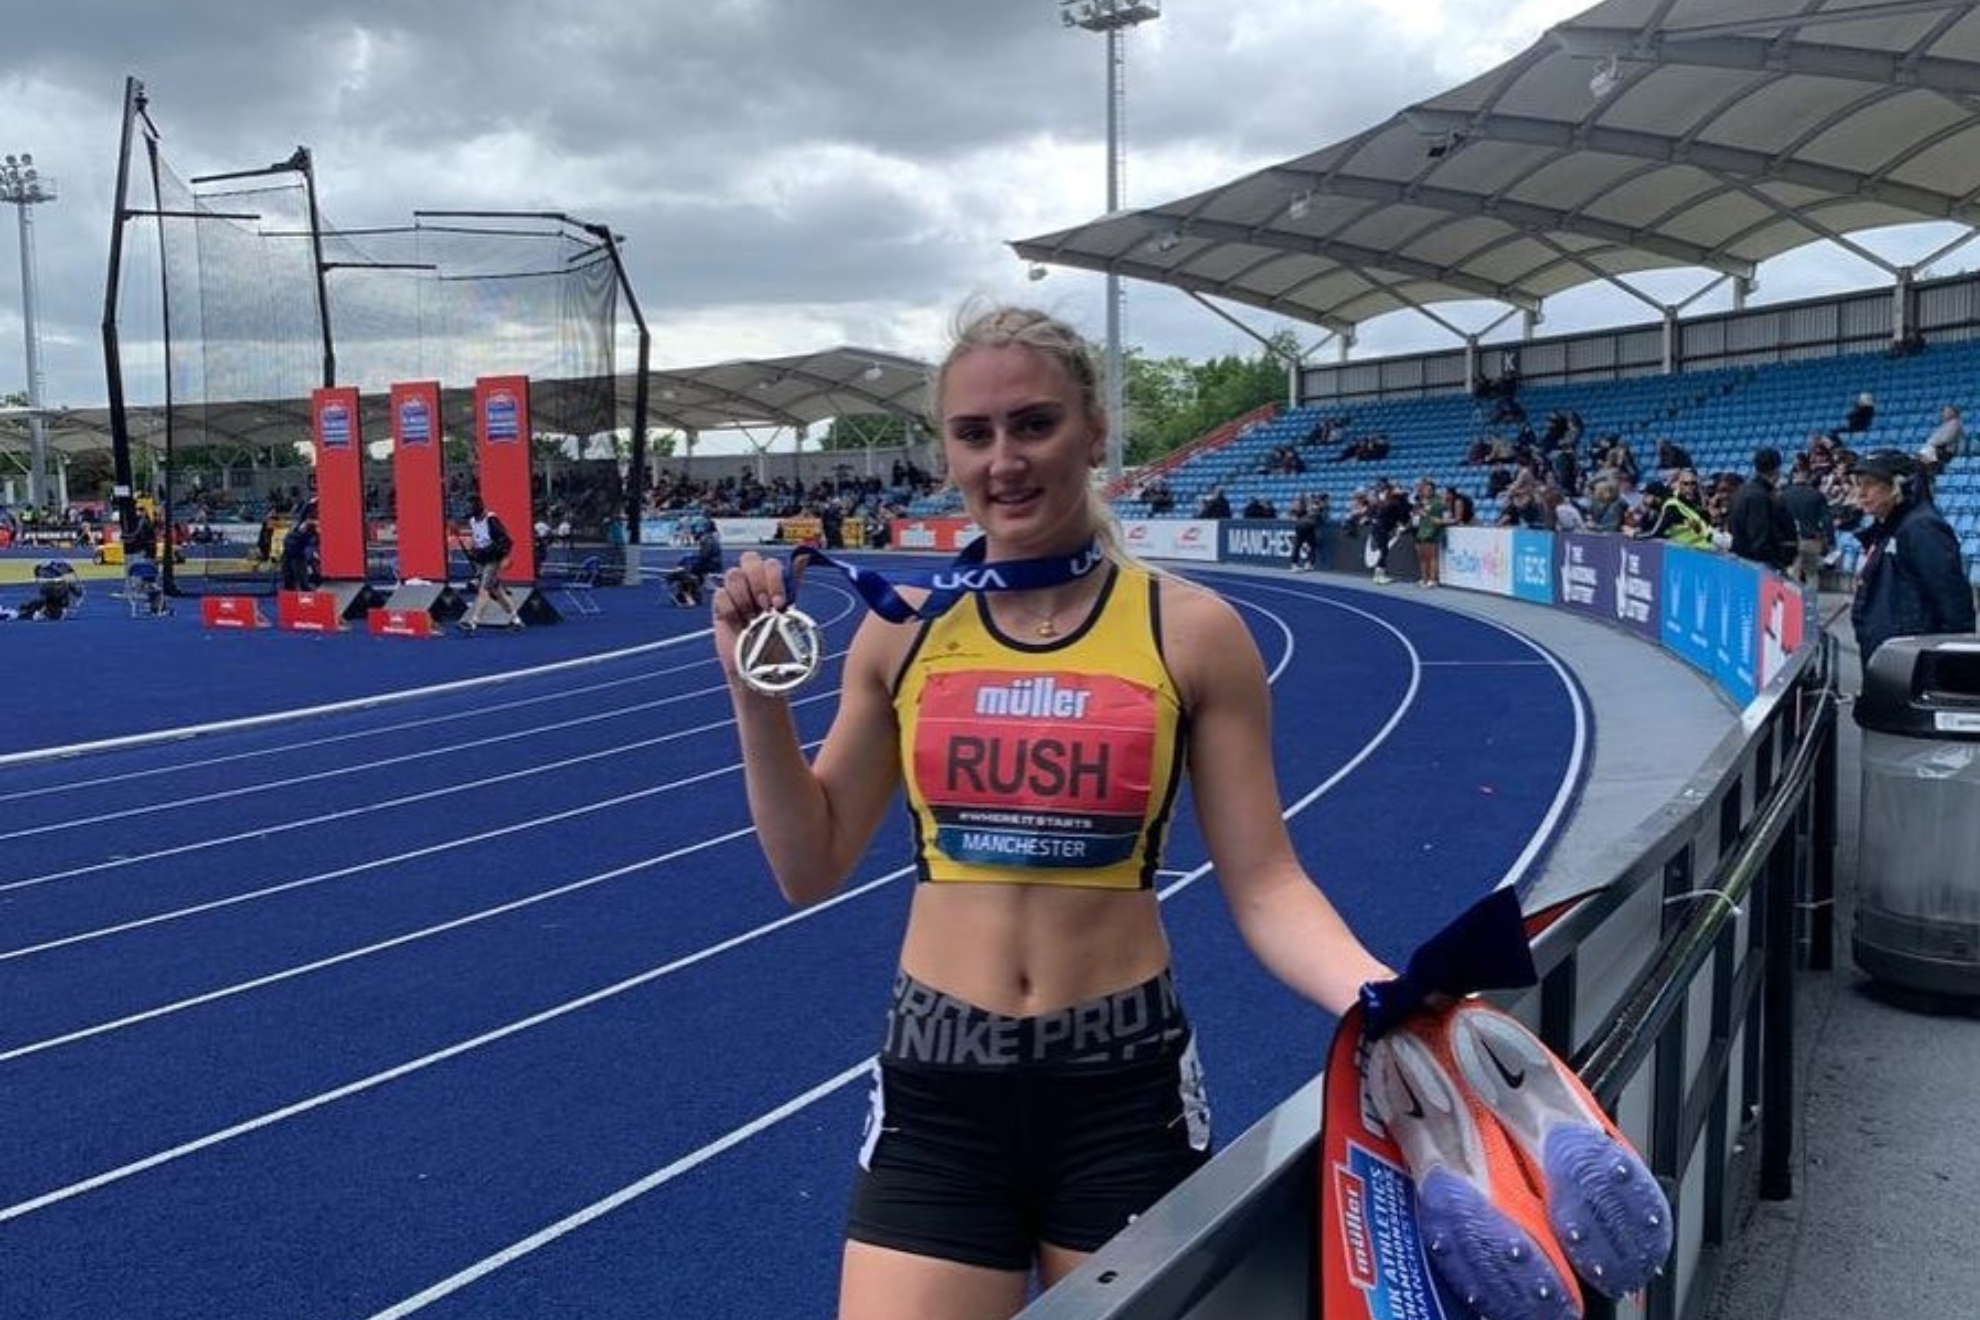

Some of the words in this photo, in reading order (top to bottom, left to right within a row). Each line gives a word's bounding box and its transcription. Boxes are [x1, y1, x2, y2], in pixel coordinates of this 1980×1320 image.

[975, 677, 1091, 718] müller
[947, 735, 1110, 799] RUSH
[961, 832, 1086, 858] MANCHESTER
[899, 1012, 1019, 1065] NIKE
[1031, 984, 1145, 1060] PRO
[1370, 1165, 1397, 1284] ATHLETICS
